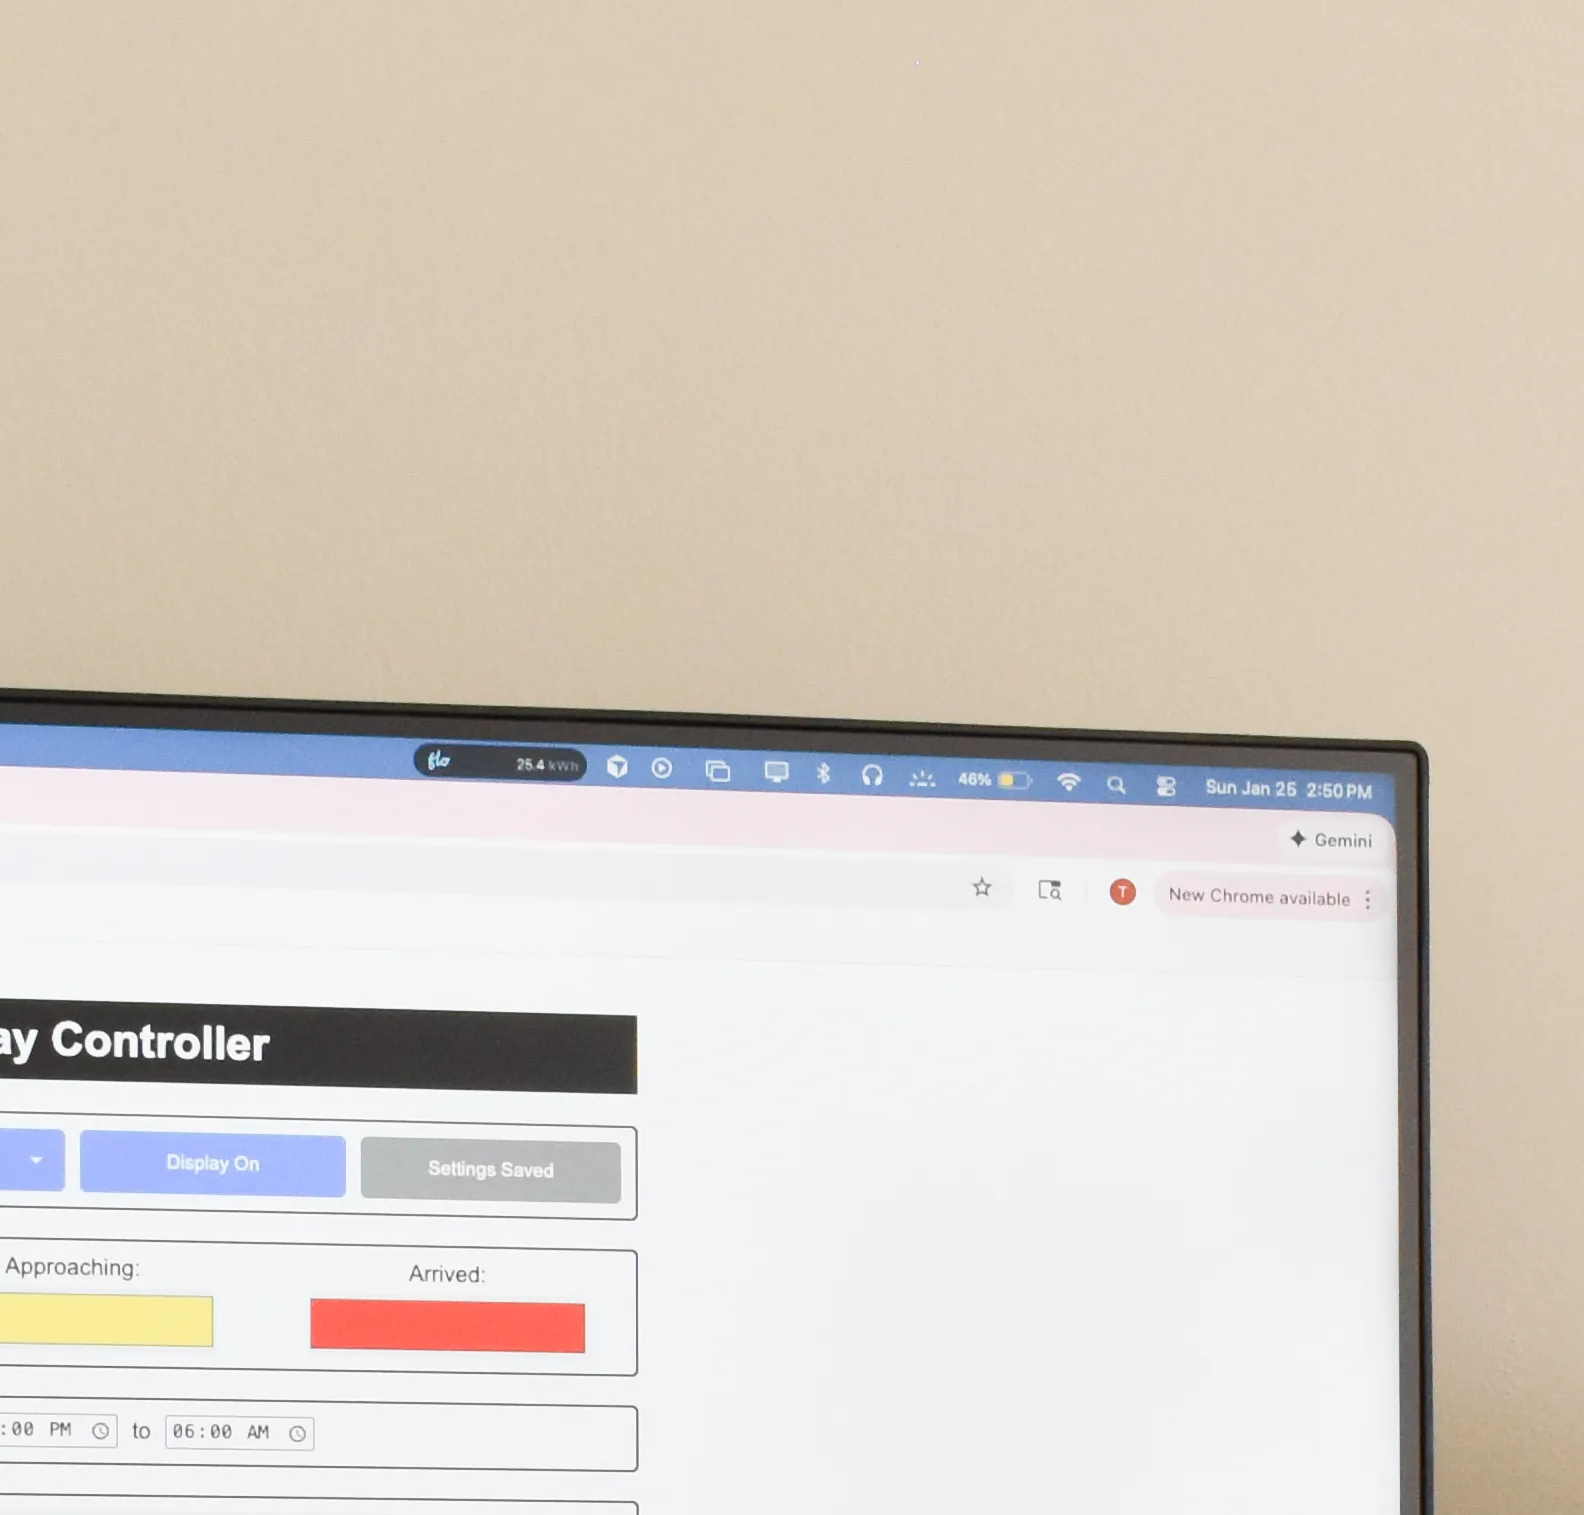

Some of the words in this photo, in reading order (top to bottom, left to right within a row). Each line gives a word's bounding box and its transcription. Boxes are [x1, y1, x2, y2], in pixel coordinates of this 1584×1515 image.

[516, 758, 546, 772] 25.4
[549, 760, 580, 773] kWh
[1206, 778, 1237, 795] Sun
[1242, 780, 1271, 796] Jan
[1307, 782, 1344, 799] 2:50
[1347, 784, 1373, 800] PM
[1314, 832, 1373, 849] Gemini
[1118, 885, 1128, 898] T
[1169, 887, 1205, 902] New
[1210, 887, 1274, 905] Chrome
[1279, 891, 1351, 907] available
[52, 1020, 270, 1061] Controller
[166, 1152, 231, 1175] Display
[233, 1154, 261, 1172] On
[428, 1159, 497, 1181] Settings
[500, 1161, 555, 1179] Saved
[5, 1256, 141, 1282] Approaching:
[408, 1264, 487, 1284] Arrived:
[49, 1421, 72, 1437] PM
[132, 1422, 151, 1440] to
[172, 1423, 233, 1440] 06:00
[247, 1424, 270, 1440] AM
